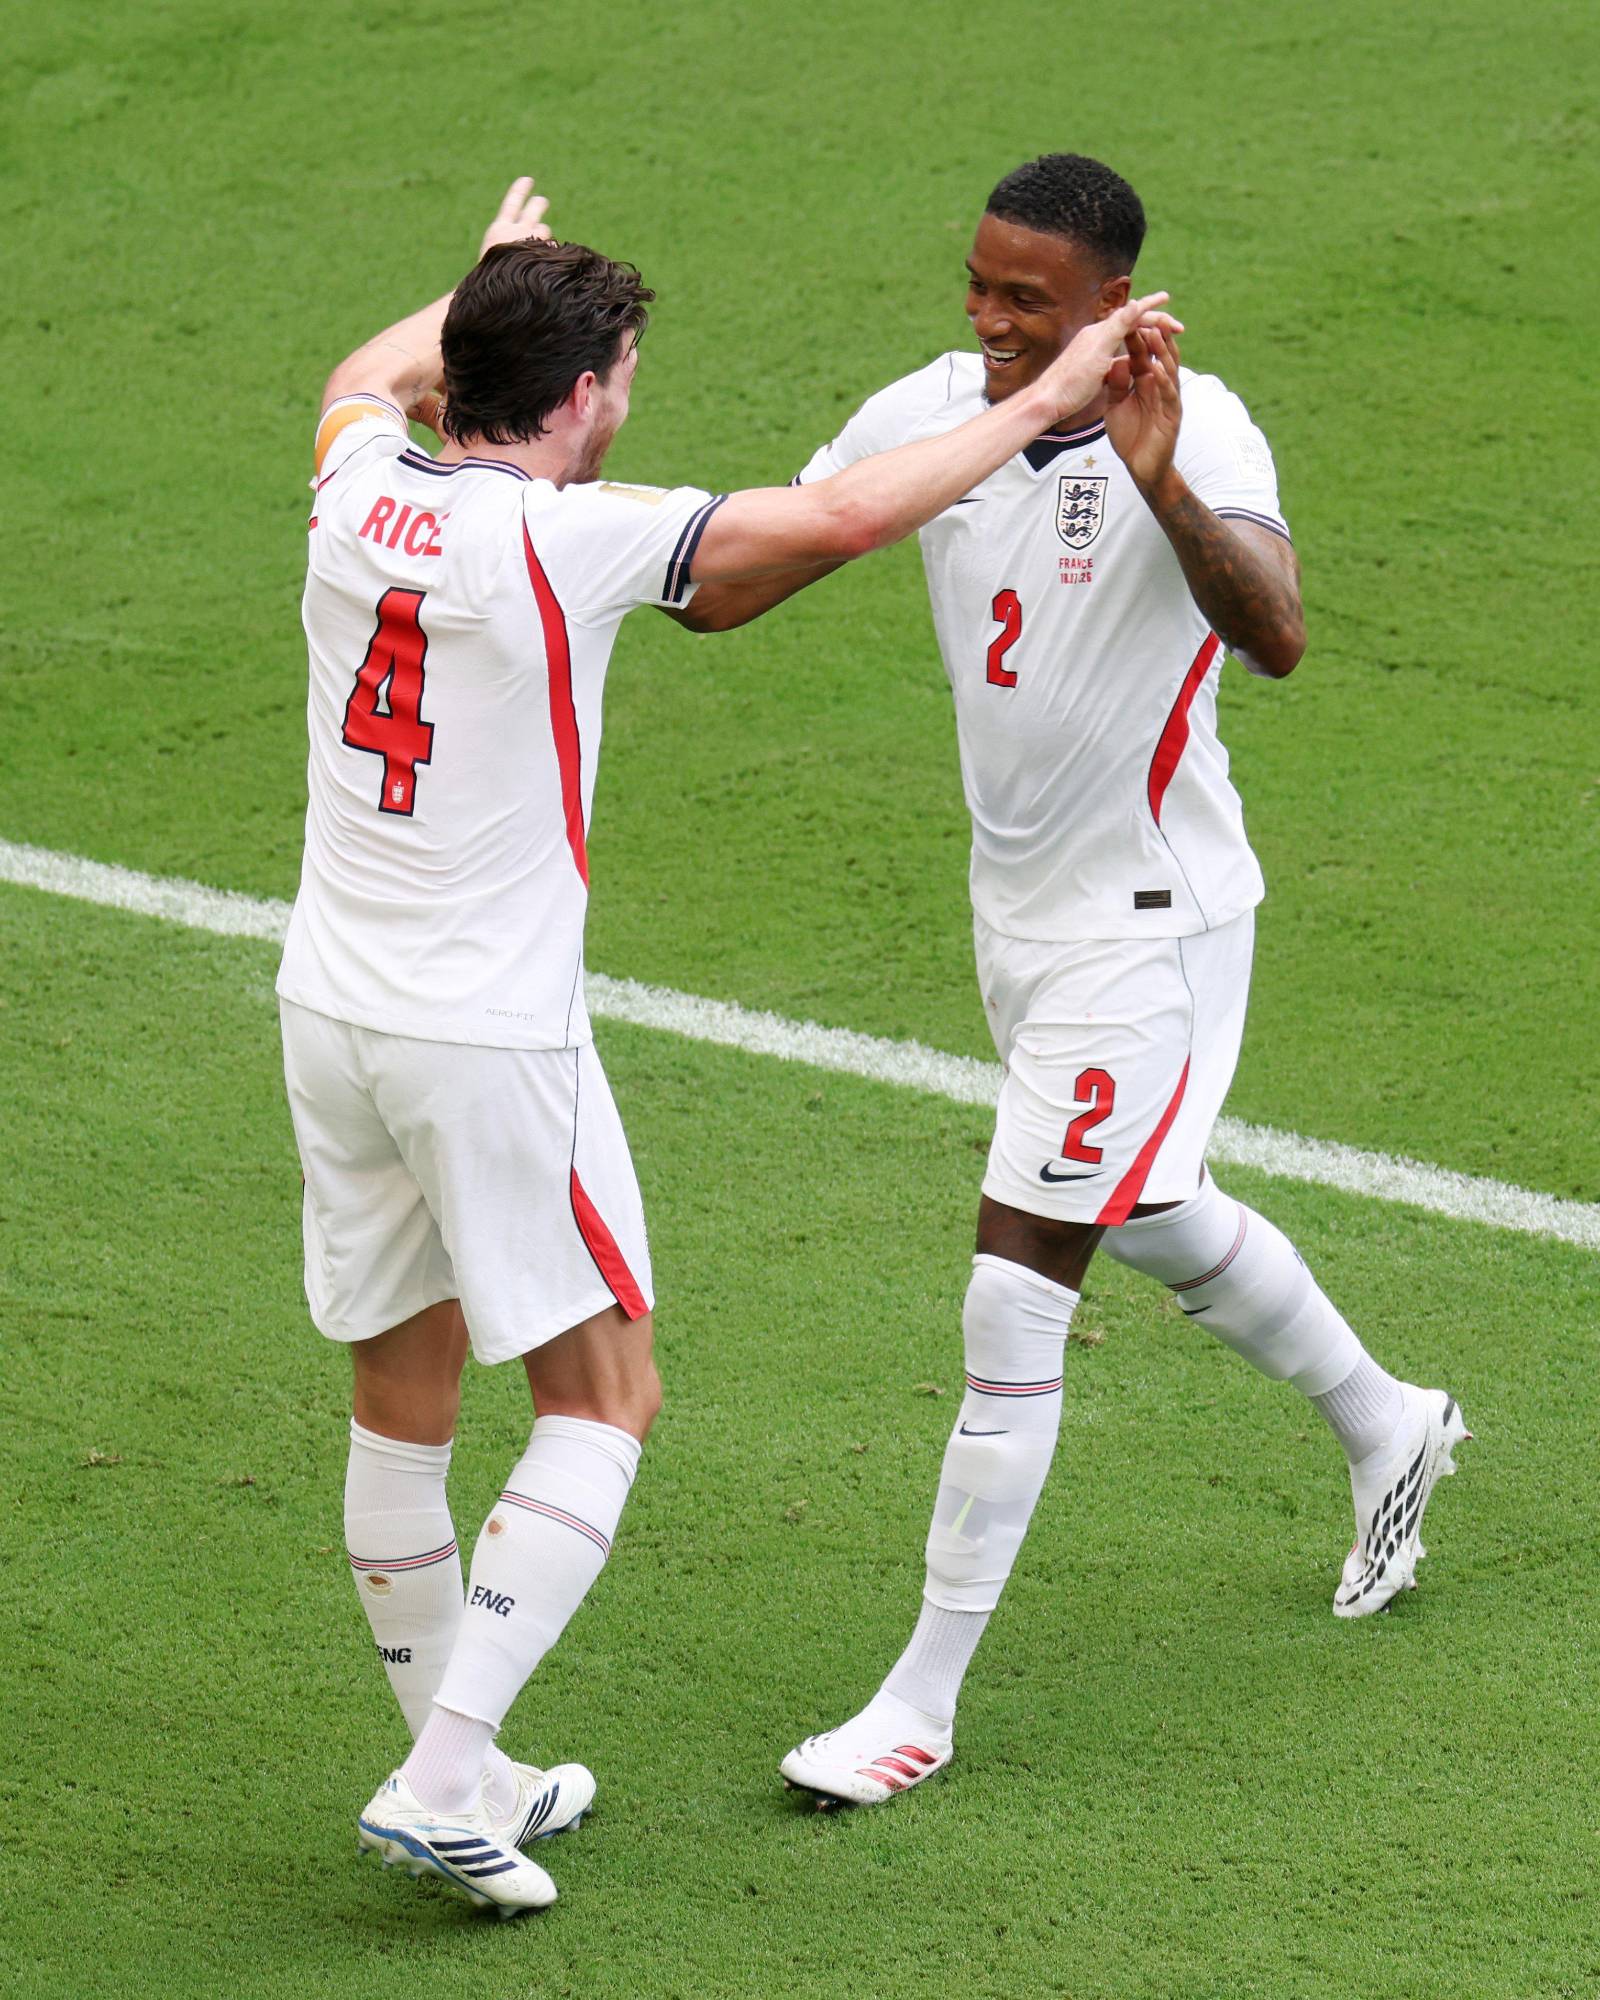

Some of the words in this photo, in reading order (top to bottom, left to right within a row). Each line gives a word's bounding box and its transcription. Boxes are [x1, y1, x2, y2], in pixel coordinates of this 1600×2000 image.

[358, 496, 451, 557] RICE
[1059, 557, 1094, 570] FRANCE
[986, 589, 1022, 688] 2
[342, 586, 435, 817] 4
[1061, 1067, 1116, 1164] 2
[470, 1585, 515, 1617] ENG
